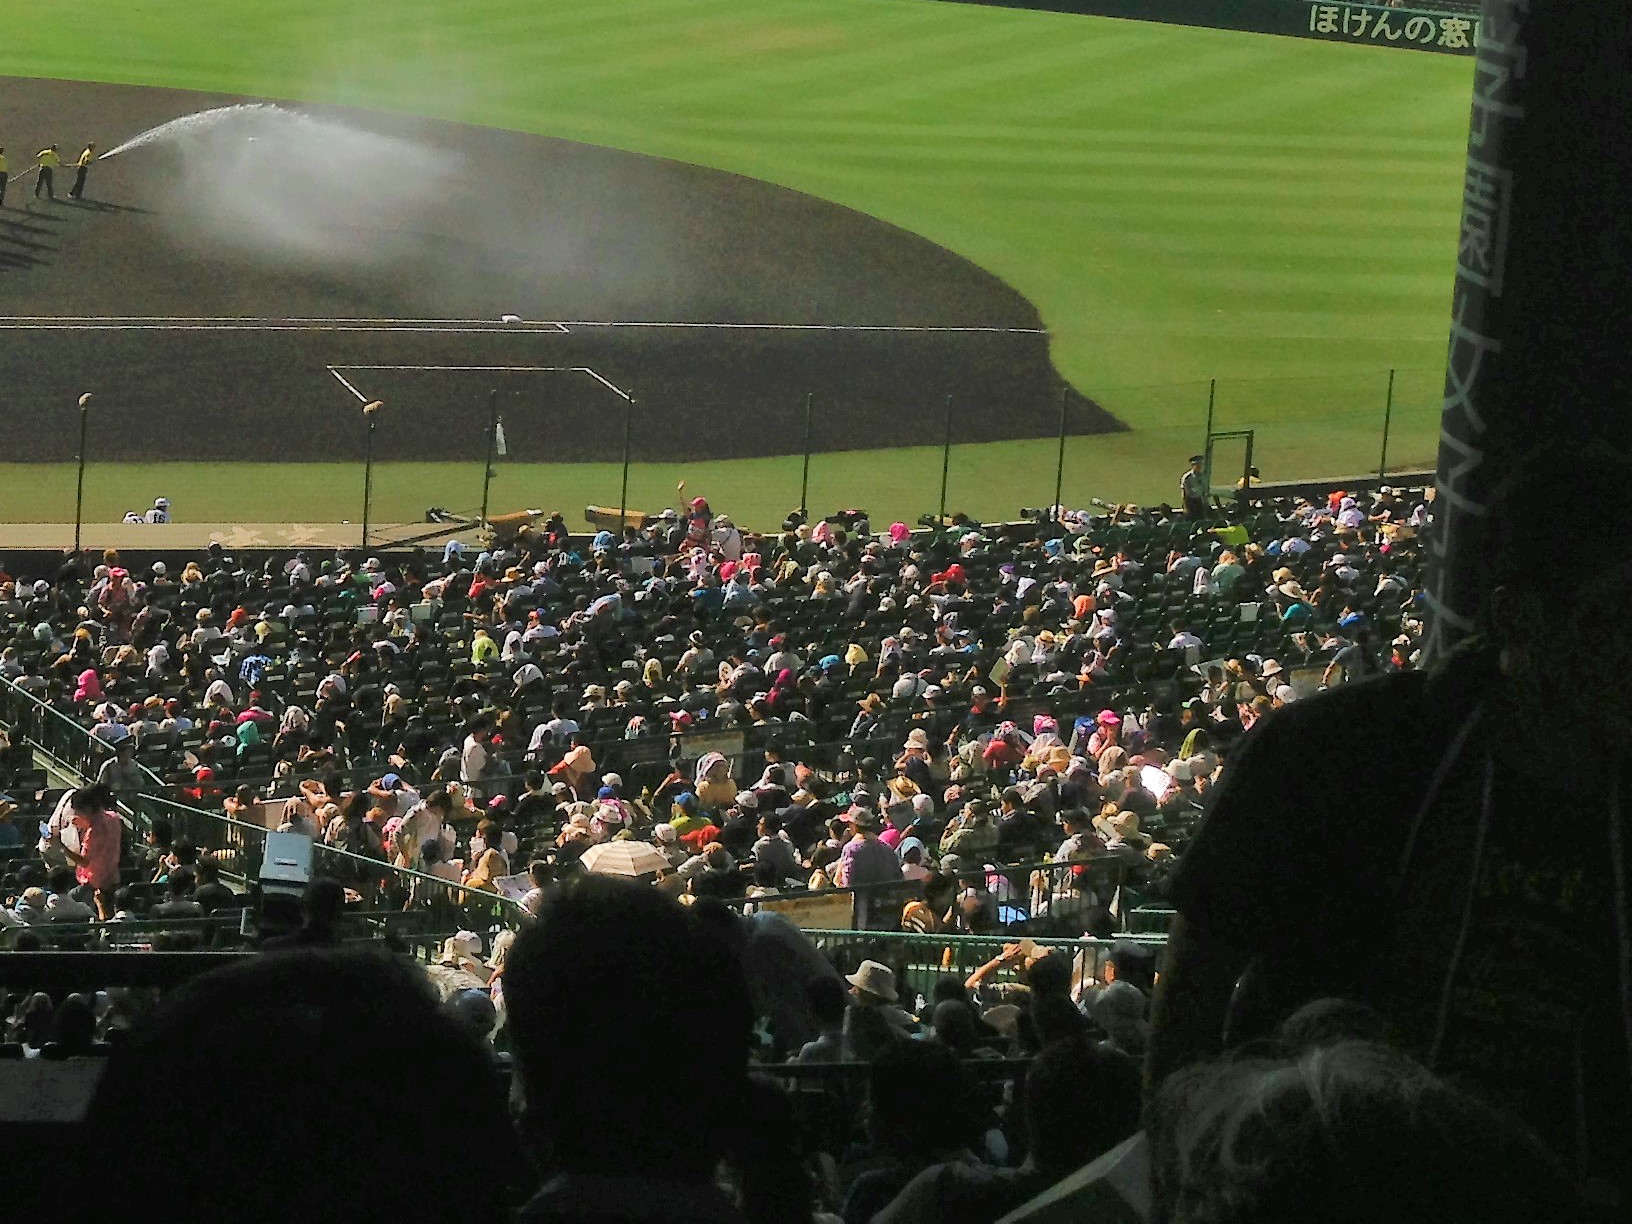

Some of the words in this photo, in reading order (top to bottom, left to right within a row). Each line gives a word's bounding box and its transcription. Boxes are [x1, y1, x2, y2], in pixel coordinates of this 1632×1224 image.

[1308, 5, 1481, 51] ほけんの窓
